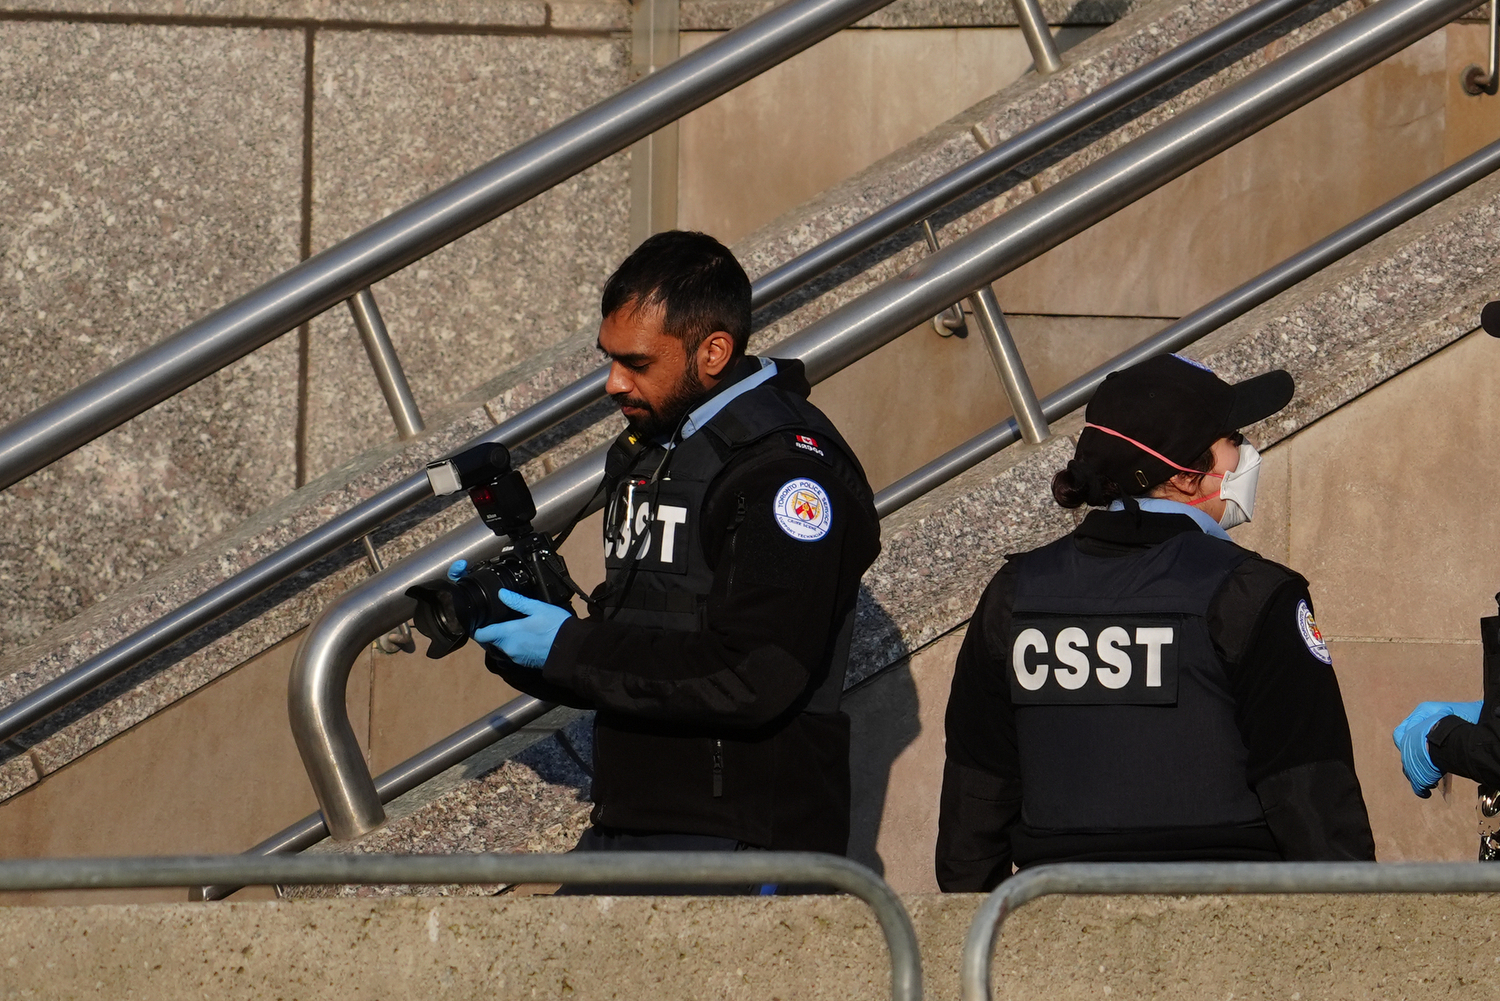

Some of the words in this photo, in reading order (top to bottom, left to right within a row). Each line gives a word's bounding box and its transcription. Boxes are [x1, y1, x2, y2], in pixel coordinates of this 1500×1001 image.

[778, 482, 798, 508] TORONTO
[799, 481, 823, 496] POLICE
[1012, 625, 1174, 691] CSST
